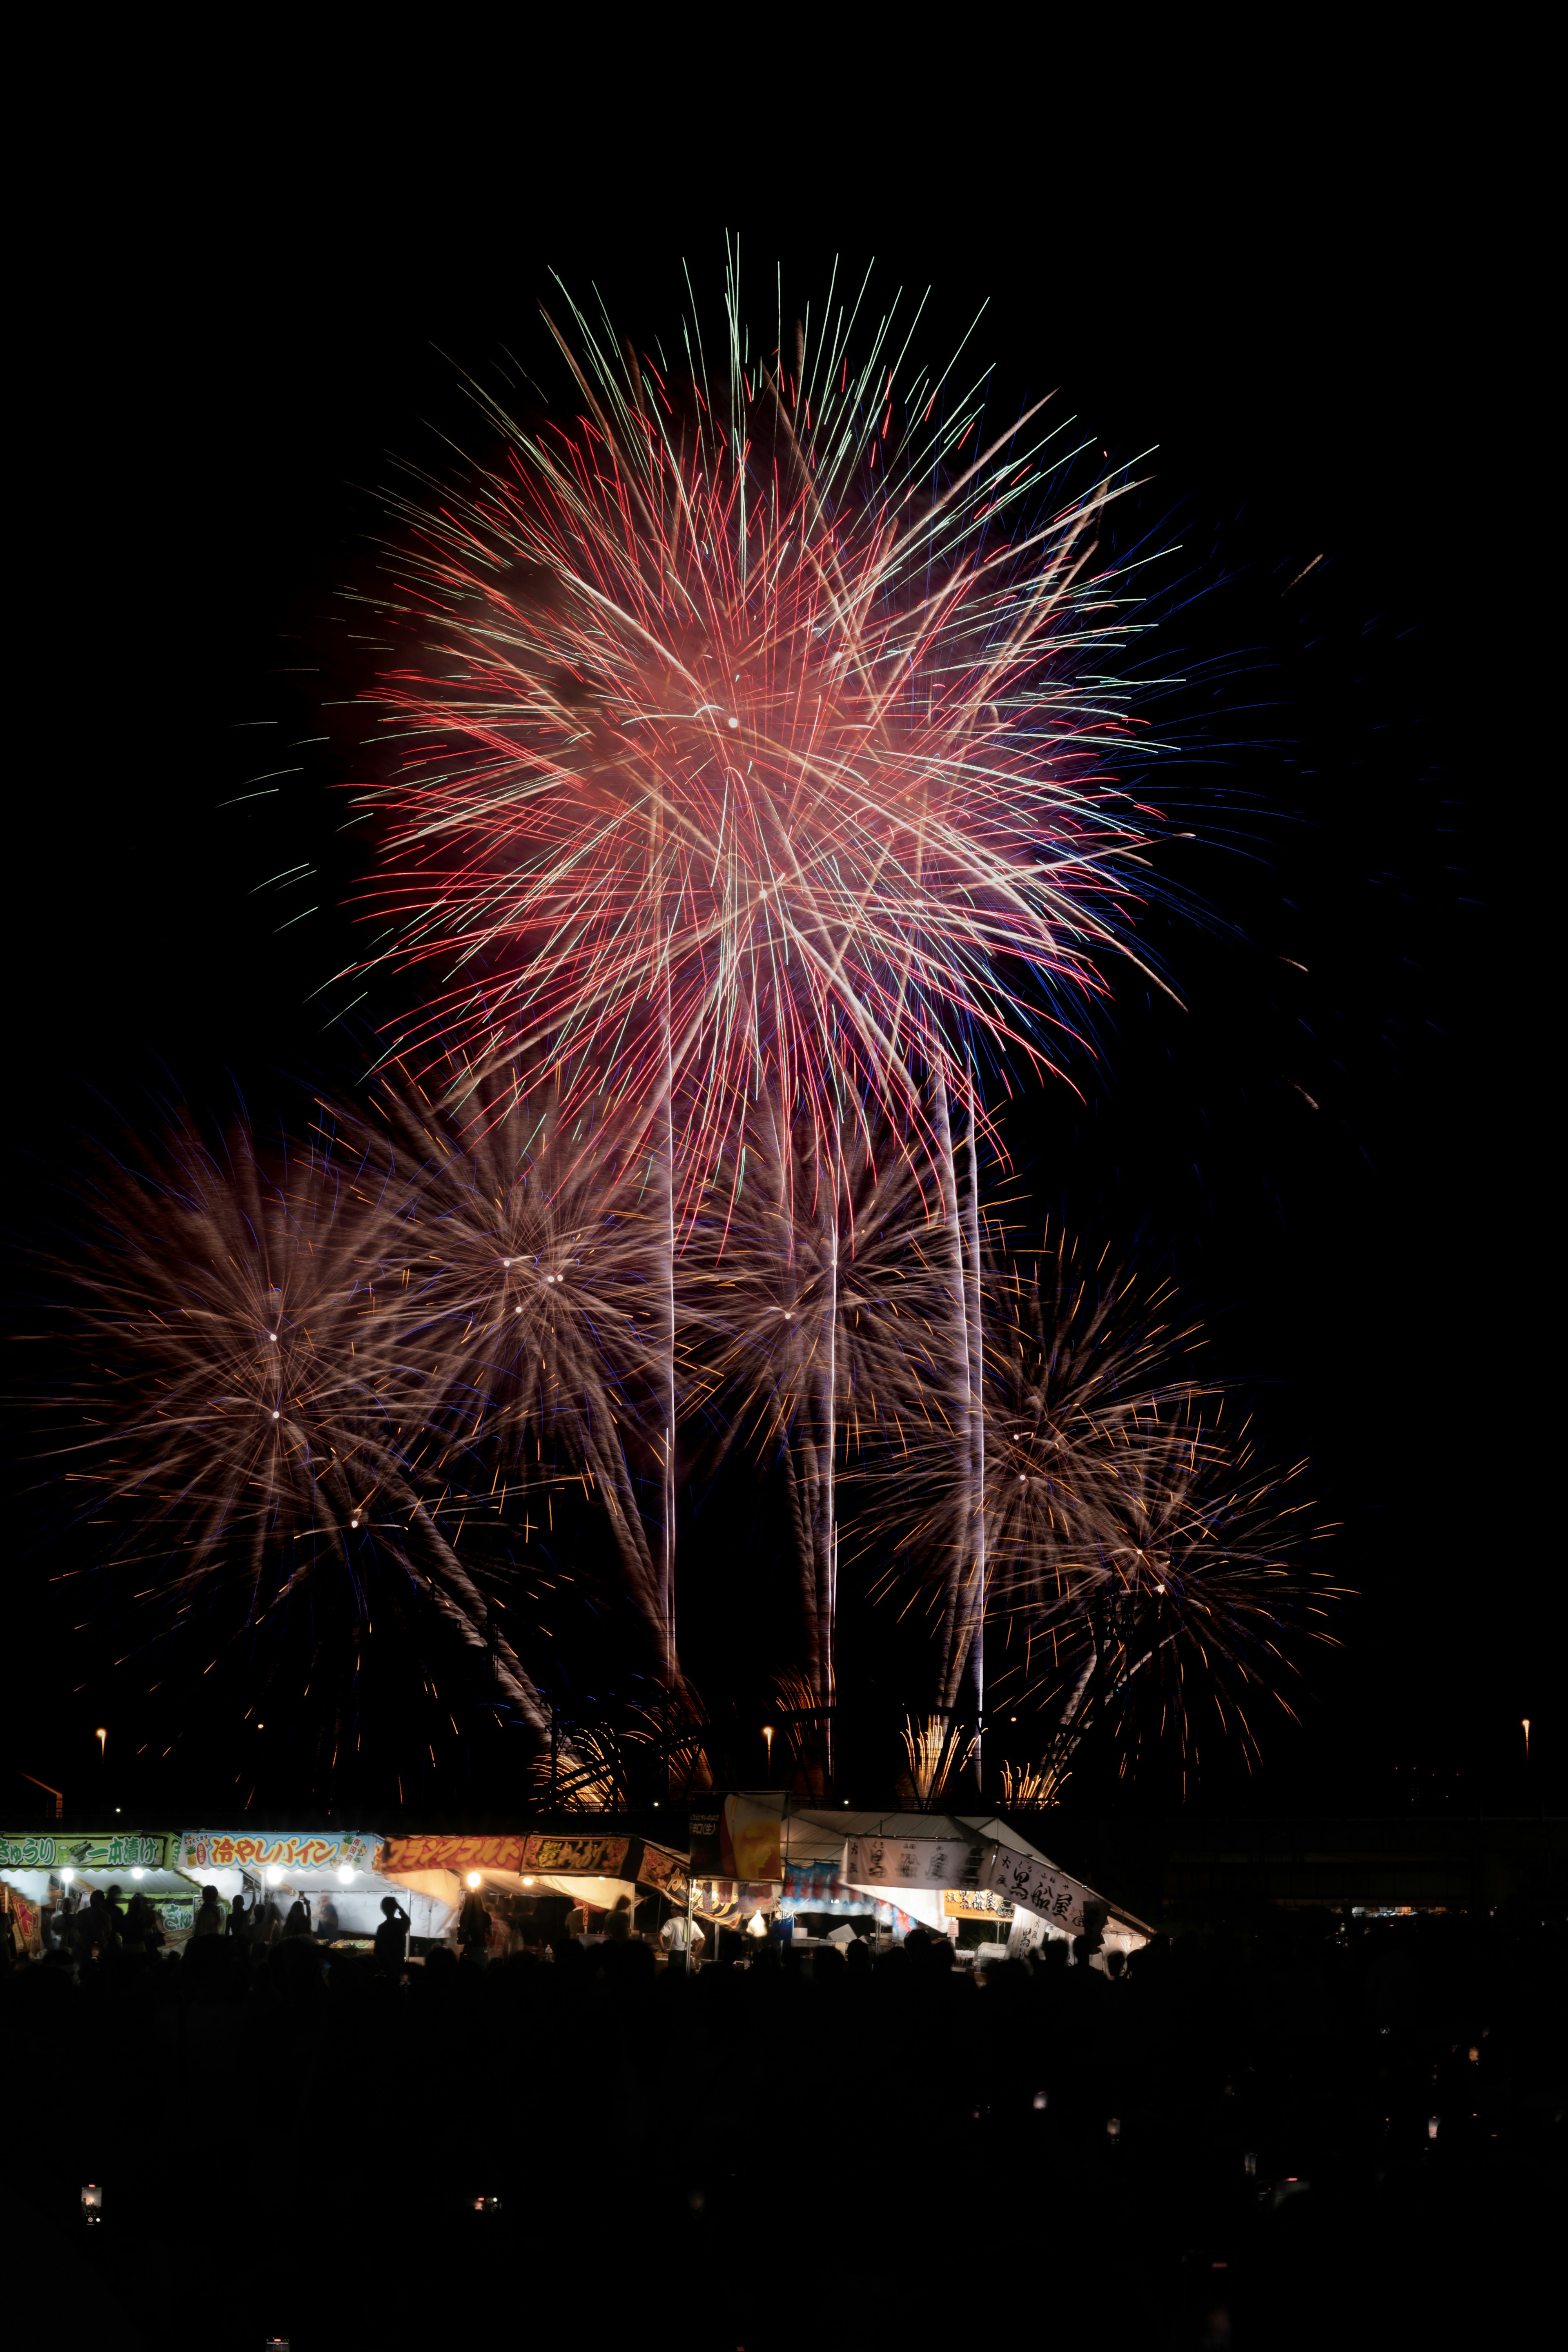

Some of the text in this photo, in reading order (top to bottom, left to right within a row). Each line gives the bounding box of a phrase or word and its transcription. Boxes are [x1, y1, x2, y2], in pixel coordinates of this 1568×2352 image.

[0, 1837, 158, 1865] きゅうり 一本漬け
[210, 1838, 336, 1864] 冷やしパイン
[388, 1839, 520, 1866] フランクフルト
[1009, 1867, 1073, 1922] 黒船屋
